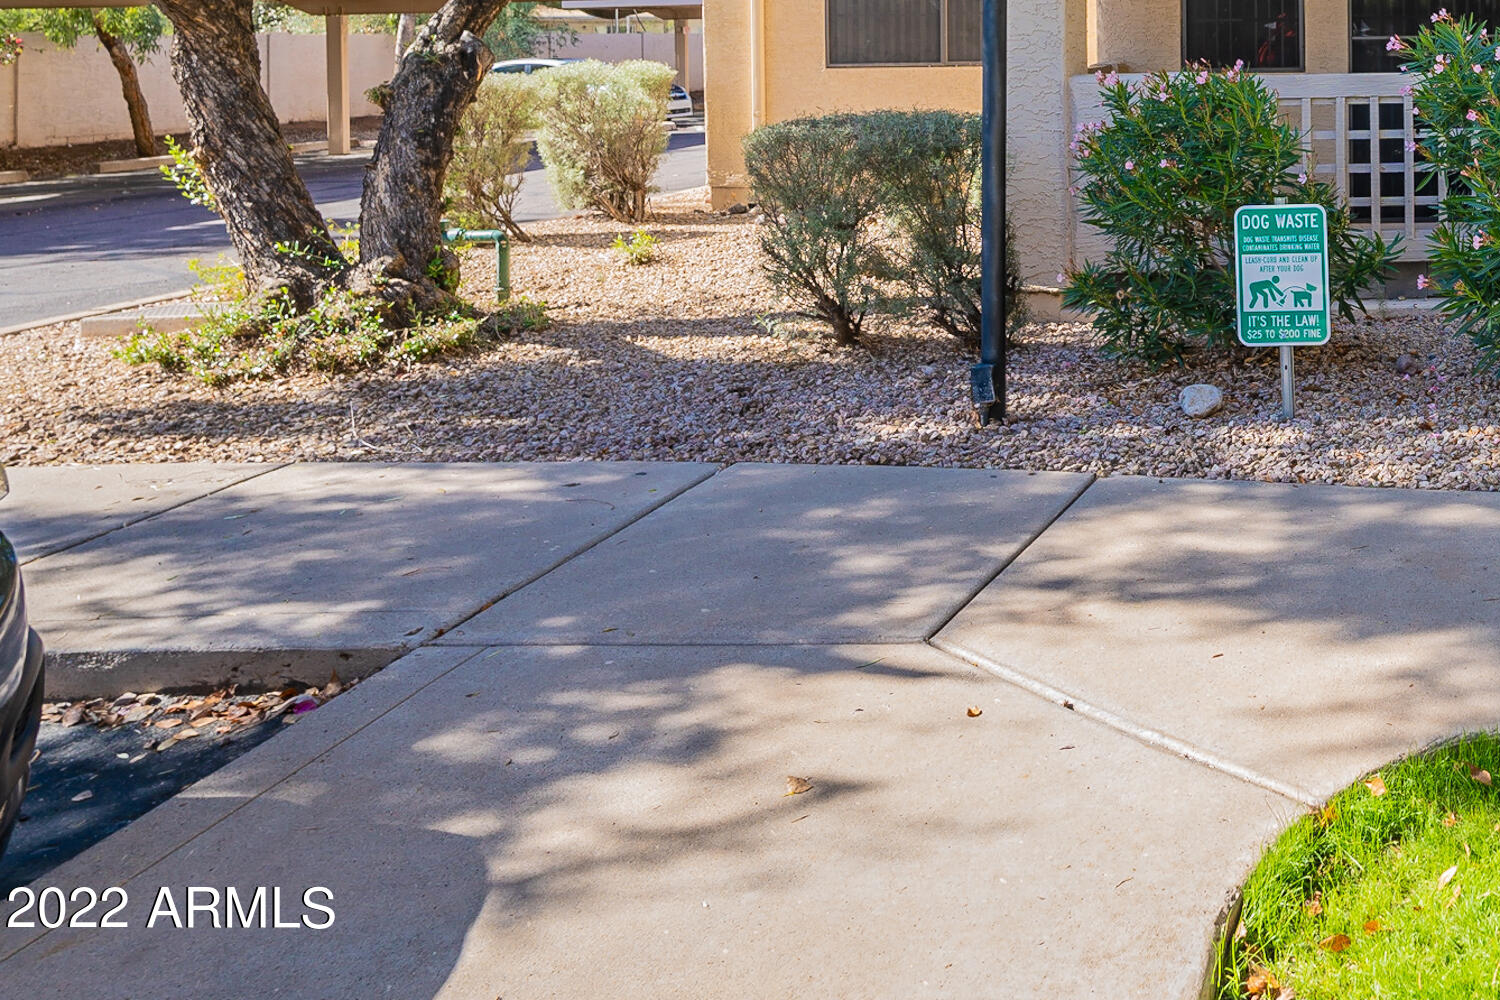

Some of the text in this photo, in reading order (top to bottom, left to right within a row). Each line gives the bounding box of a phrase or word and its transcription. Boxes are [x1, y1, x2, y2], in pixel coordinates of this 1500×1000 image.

[1241, 212, 1319, 230] DOG WASTE
[1243, 233, 1319, 244] DOG WASTE TRANSMITS DISEASE
[1242, 242, 1320, 252] CONTAMINATES DRINKING WATER
[1279, 256, 1290, 264] AND
[1292, 255, 1309, 263] CLEAN
[1310, 255, 1318, 263] UP
[1260, 264, 1304, 273] AFTER YOUR DOG
[1248, 314, 1320, 328] IT'S THE LAW!
[1247, 329, 1322, 340] $25 TO $200 FINE
